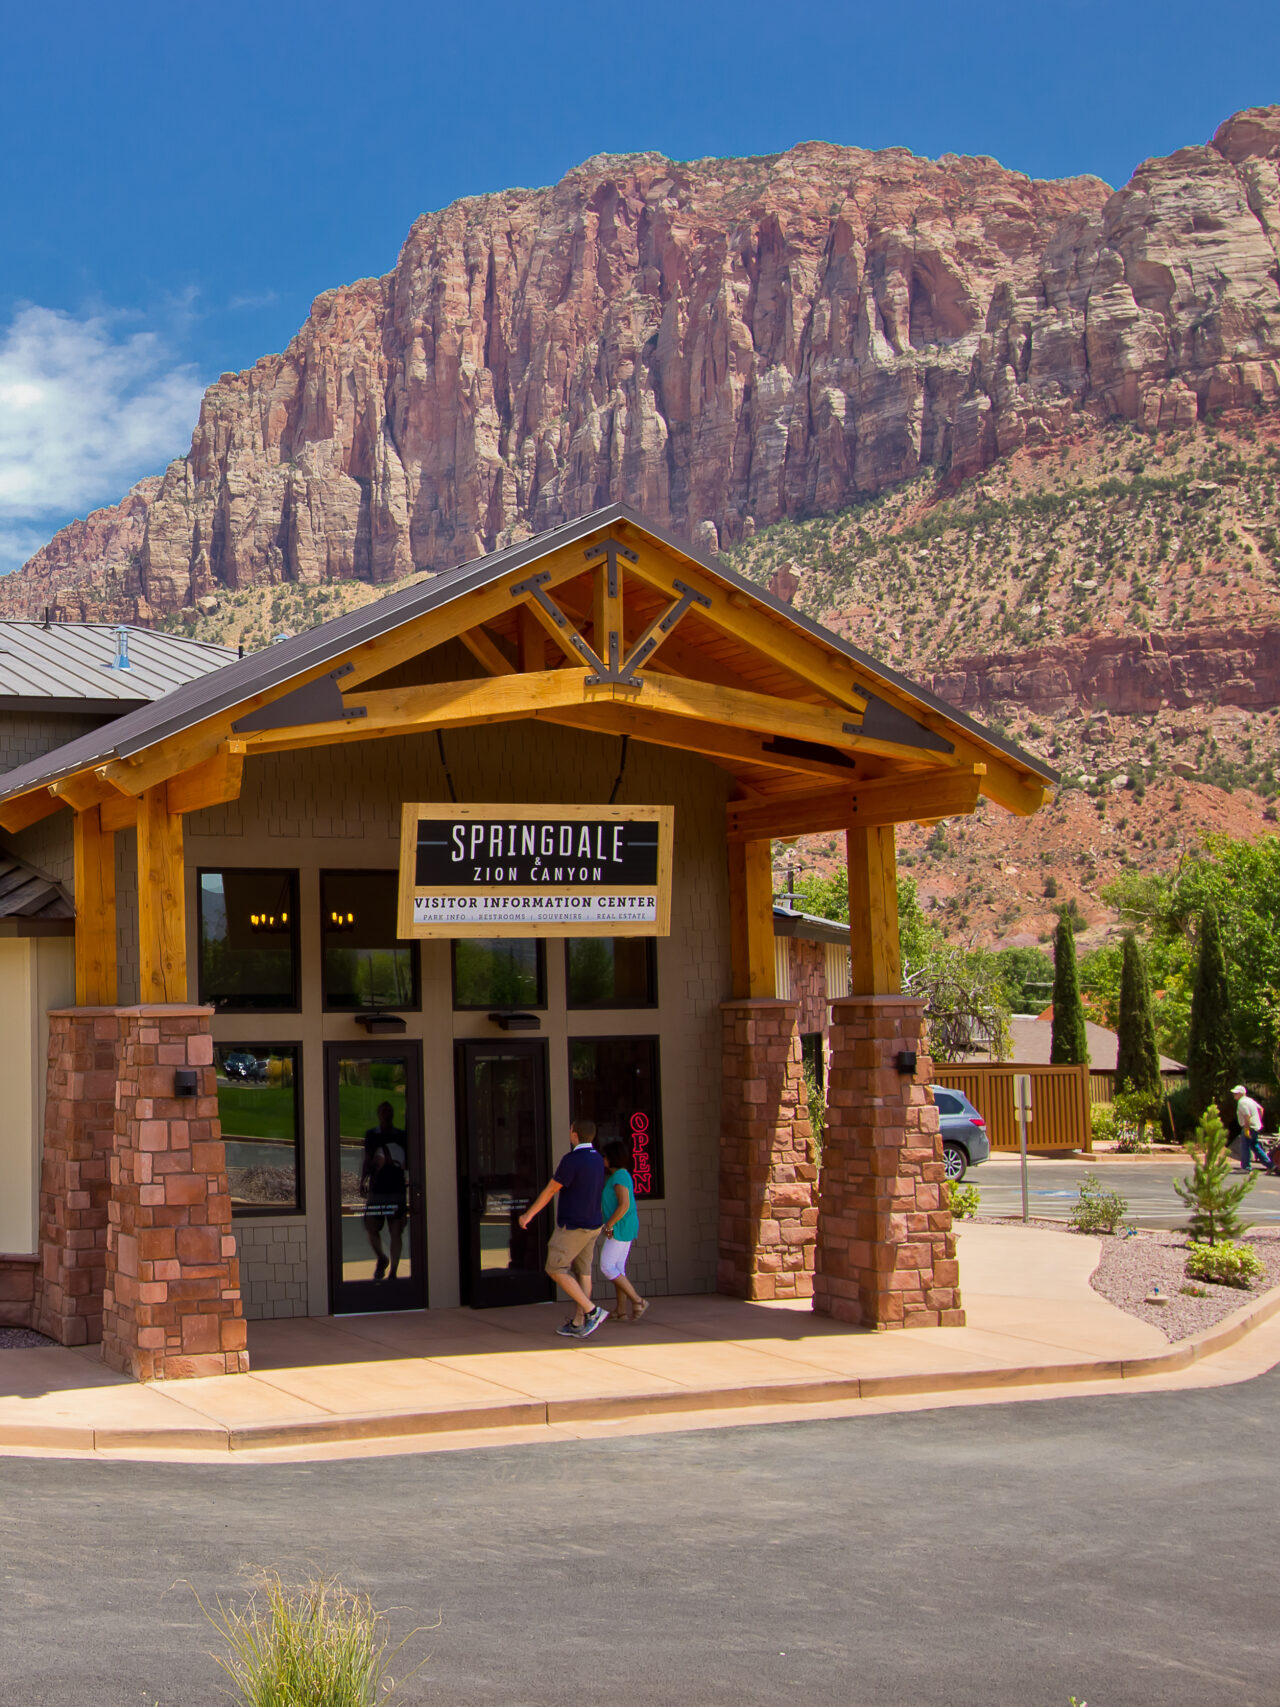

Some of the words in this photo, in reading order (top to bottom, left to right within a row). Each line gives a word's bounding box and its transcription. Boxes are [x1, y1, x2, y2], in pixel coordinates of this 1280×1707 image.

[451, 824, 624, 863] SPRINGDALE
[534, 856, 542, 866] &
[473, 867, 518, 882] ZION
[530, 867, 602, 882] CANYON
[415, 897, 478, 909] VISITOR
[483, 897, 592, 909] INFORMATION
[597, 896, 656, 909] CENTER
[618, 912, 646, 920] ESTATE
[630, 1112, 652, 1193] OPEN
